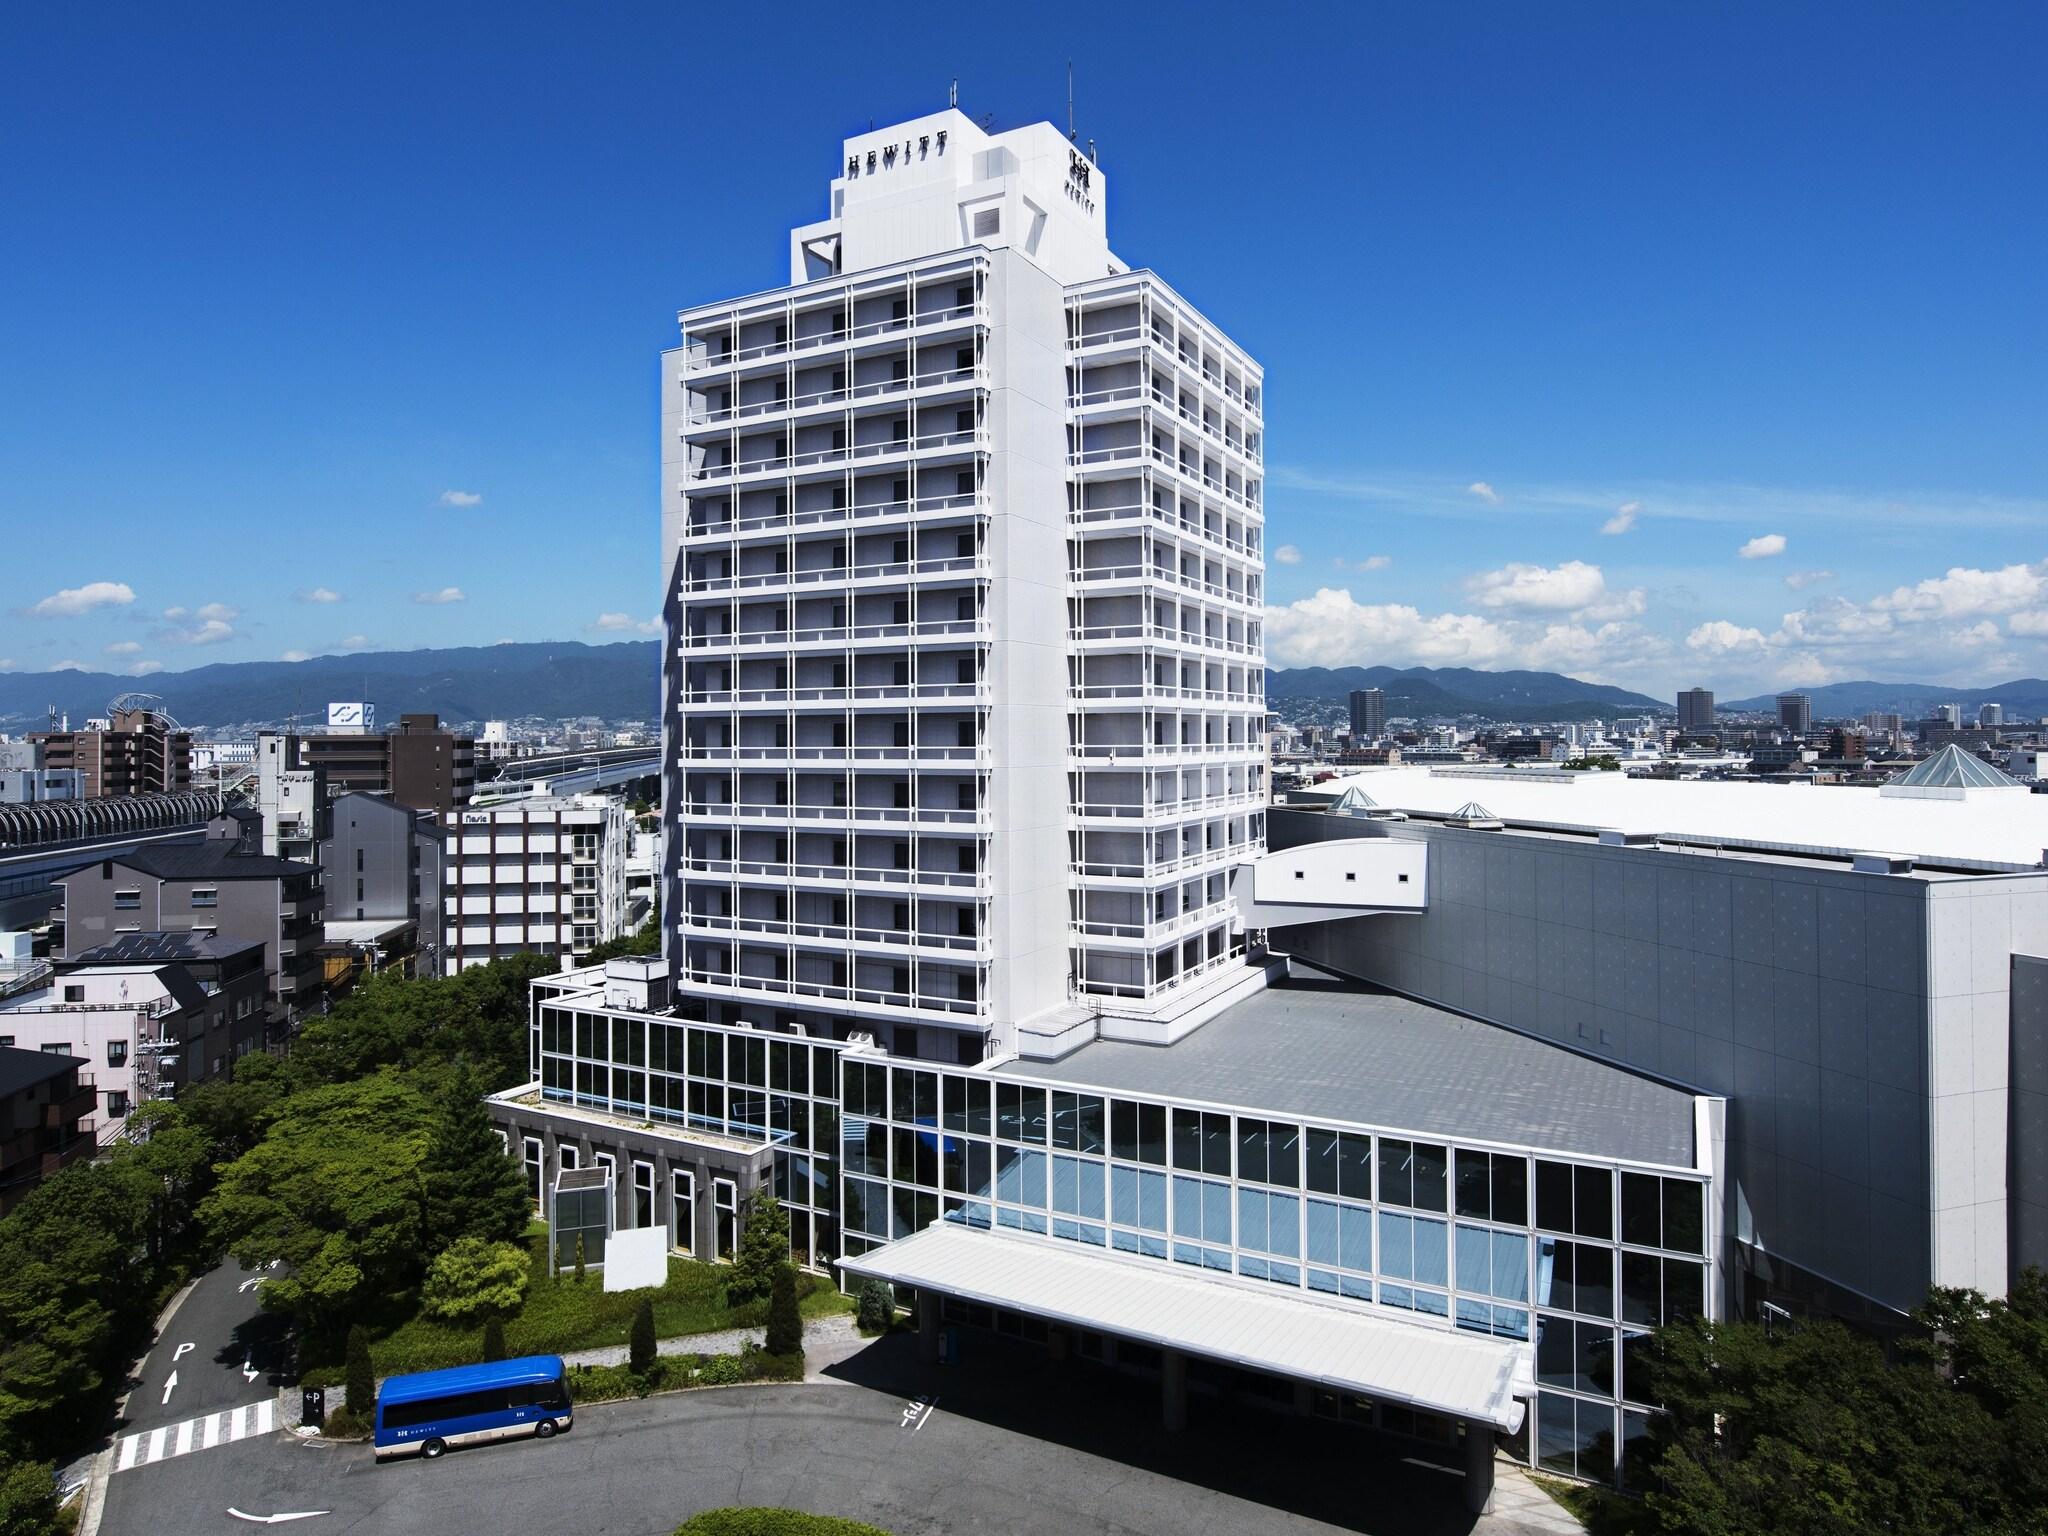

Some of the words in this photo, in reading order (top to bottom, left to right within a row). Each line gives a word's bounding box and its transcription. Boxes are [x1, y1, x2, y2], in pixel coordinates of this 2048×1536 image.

[848, 130, 948, 171] HEWITT
[172, 1343, 196, 1361] P
[313, 1392, 320, 1403] P
